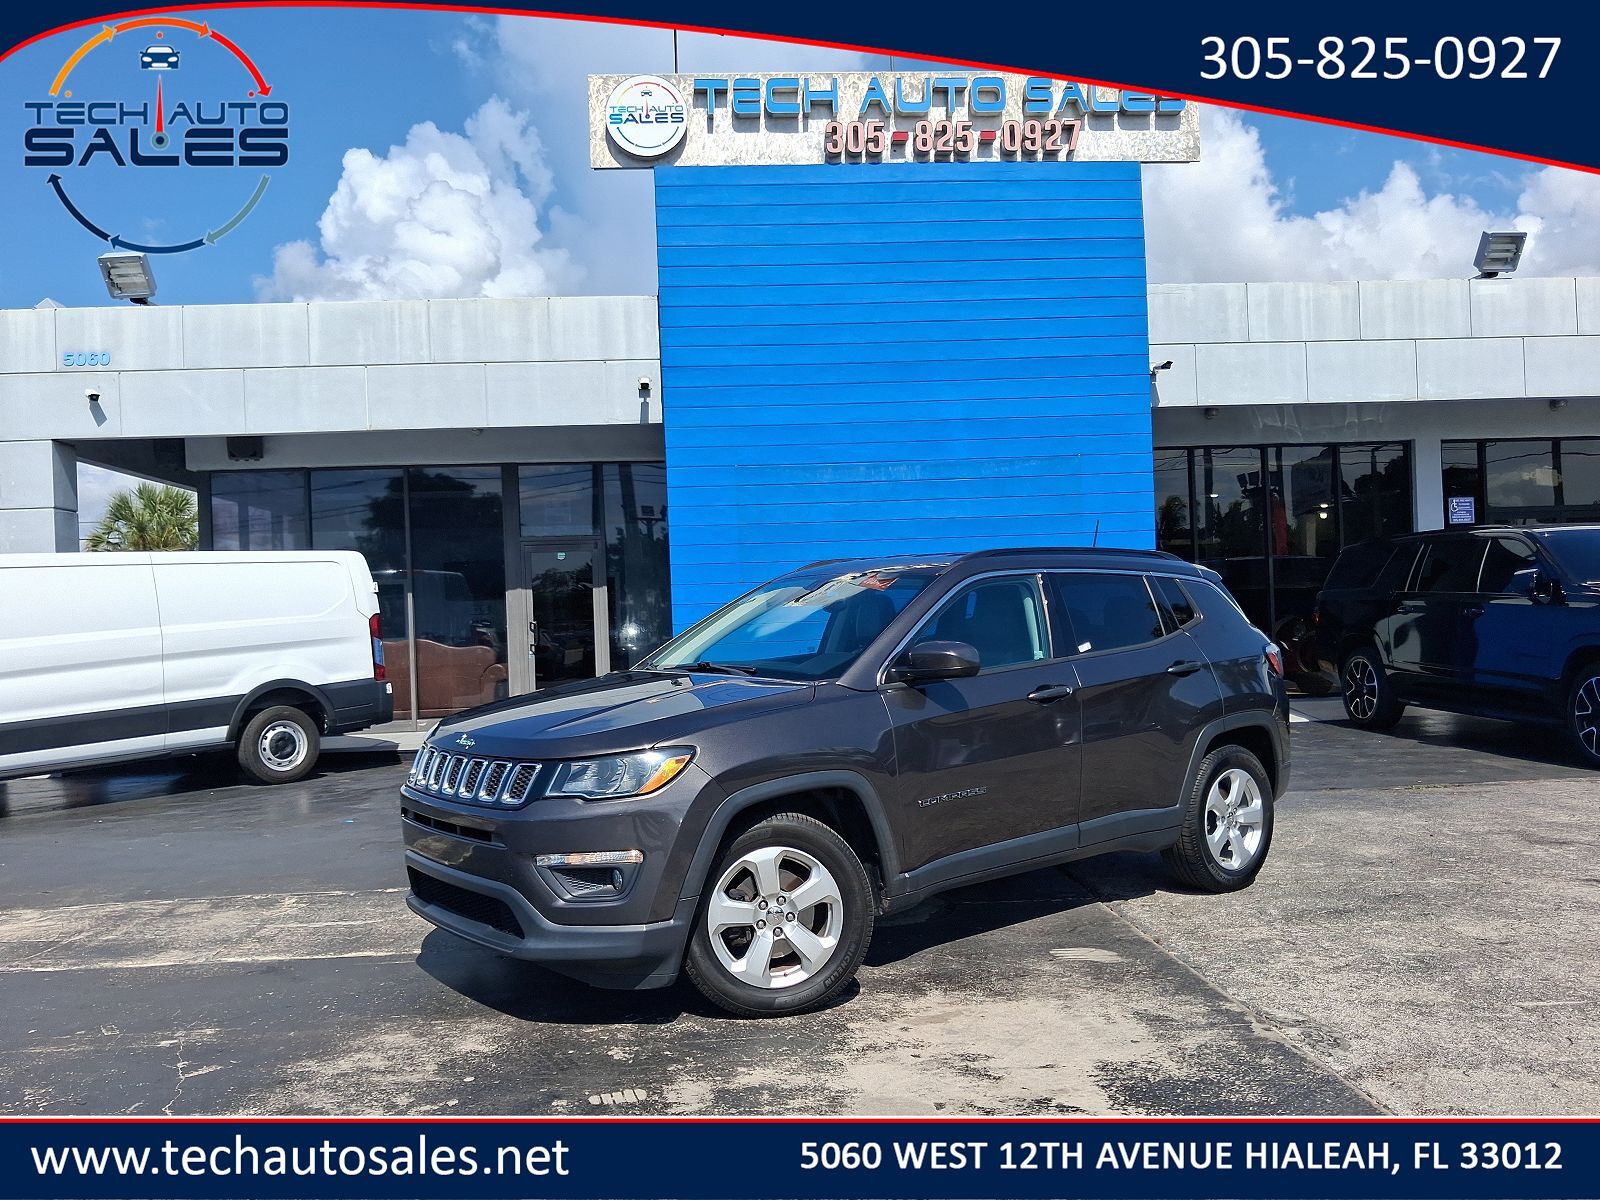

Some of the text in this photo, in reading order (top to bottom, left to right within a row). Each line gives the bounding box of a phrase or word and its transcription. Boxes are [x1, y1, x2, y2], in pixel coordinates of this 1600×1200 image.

[693, 77, 838, 115] TECH
[860, 76, 1006, 113] AUTO
[609, 104, 683, 113] TECH AUTO
[609, 112, 684, 124] SALES
[63, 351, 110, 367] 5060
